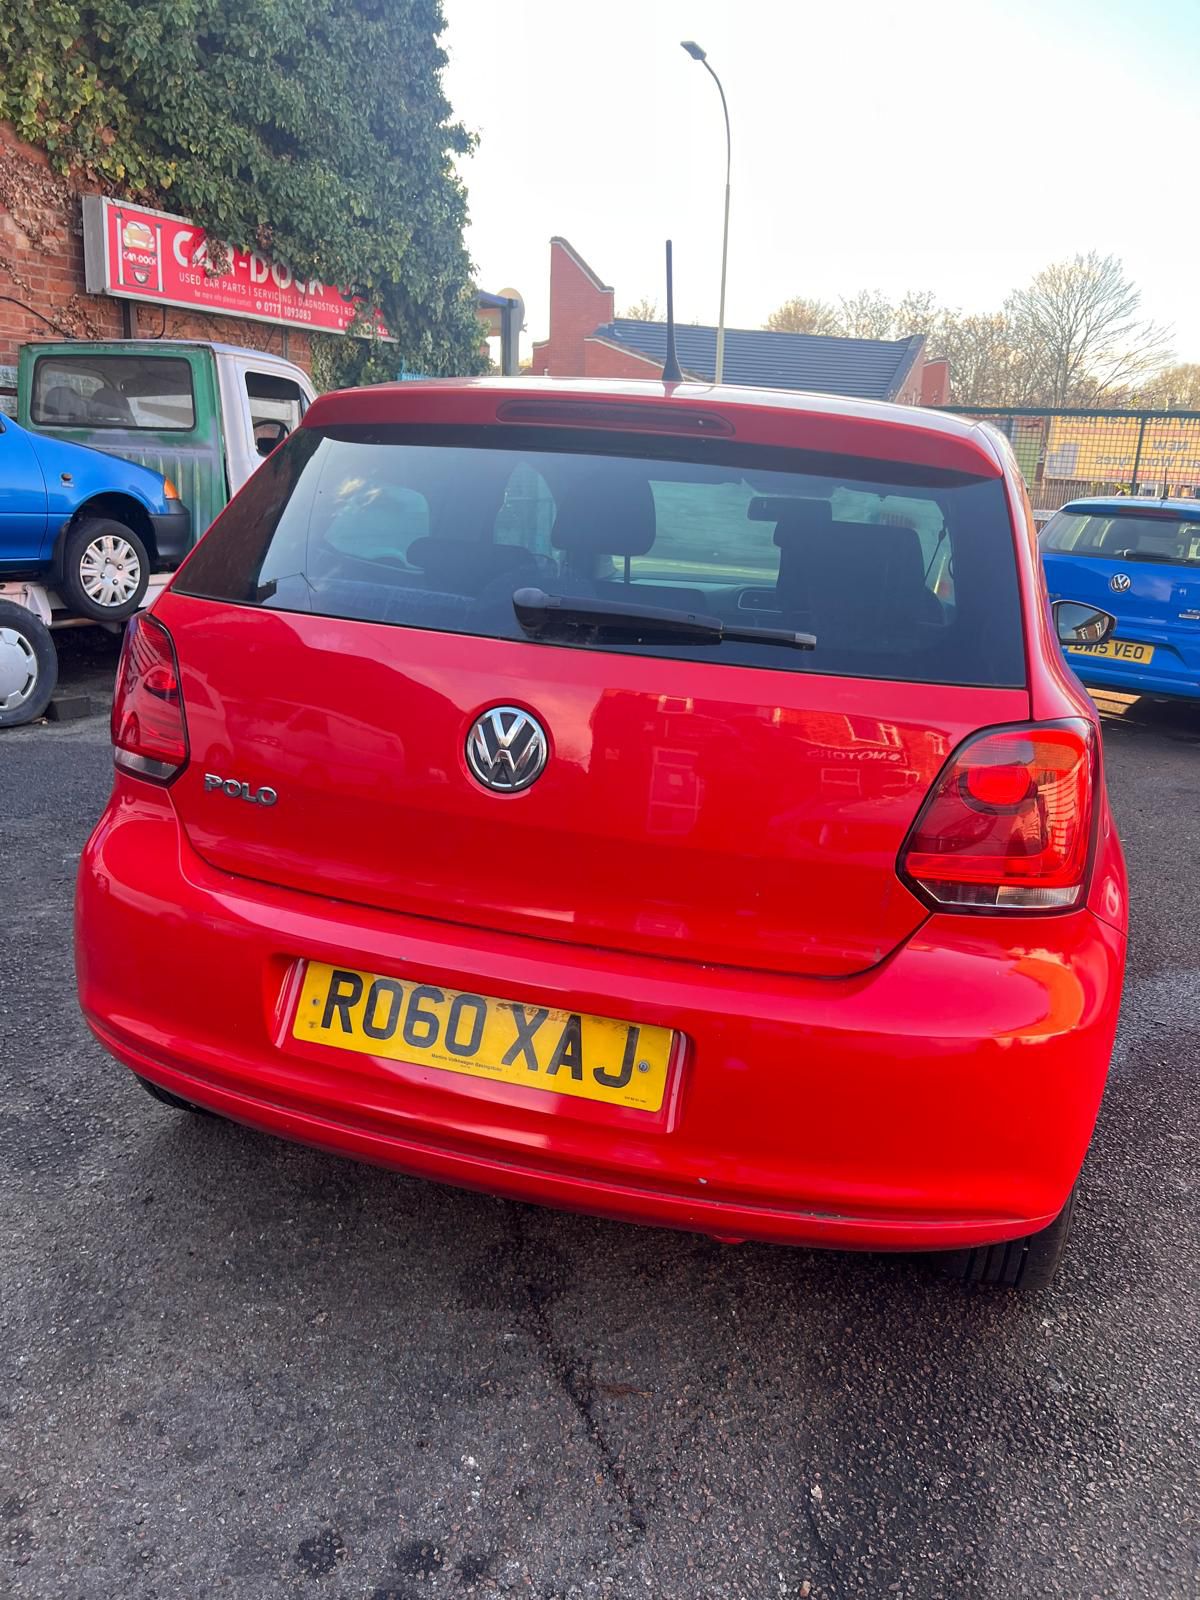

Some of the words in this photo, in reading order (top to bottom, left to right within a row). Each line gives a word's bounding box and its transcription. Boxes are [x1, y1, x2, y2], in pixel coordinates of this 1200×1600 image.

[179, 272, 201, 286] USED
[204, 277, 220, 289] CAR
[222, 281, 246, 295] PARTS
[253, 287, 292, 305] SERVICING
[264, 302, 281, 314] 0777
[1114, 642, 1144, 660] VEO
[467, 706, 548, 790] VW
[204, 773, 278, 806] POLO
[321, 970, 488, 1057] RO60
[501, 1003, 641, 1089] XAJ
